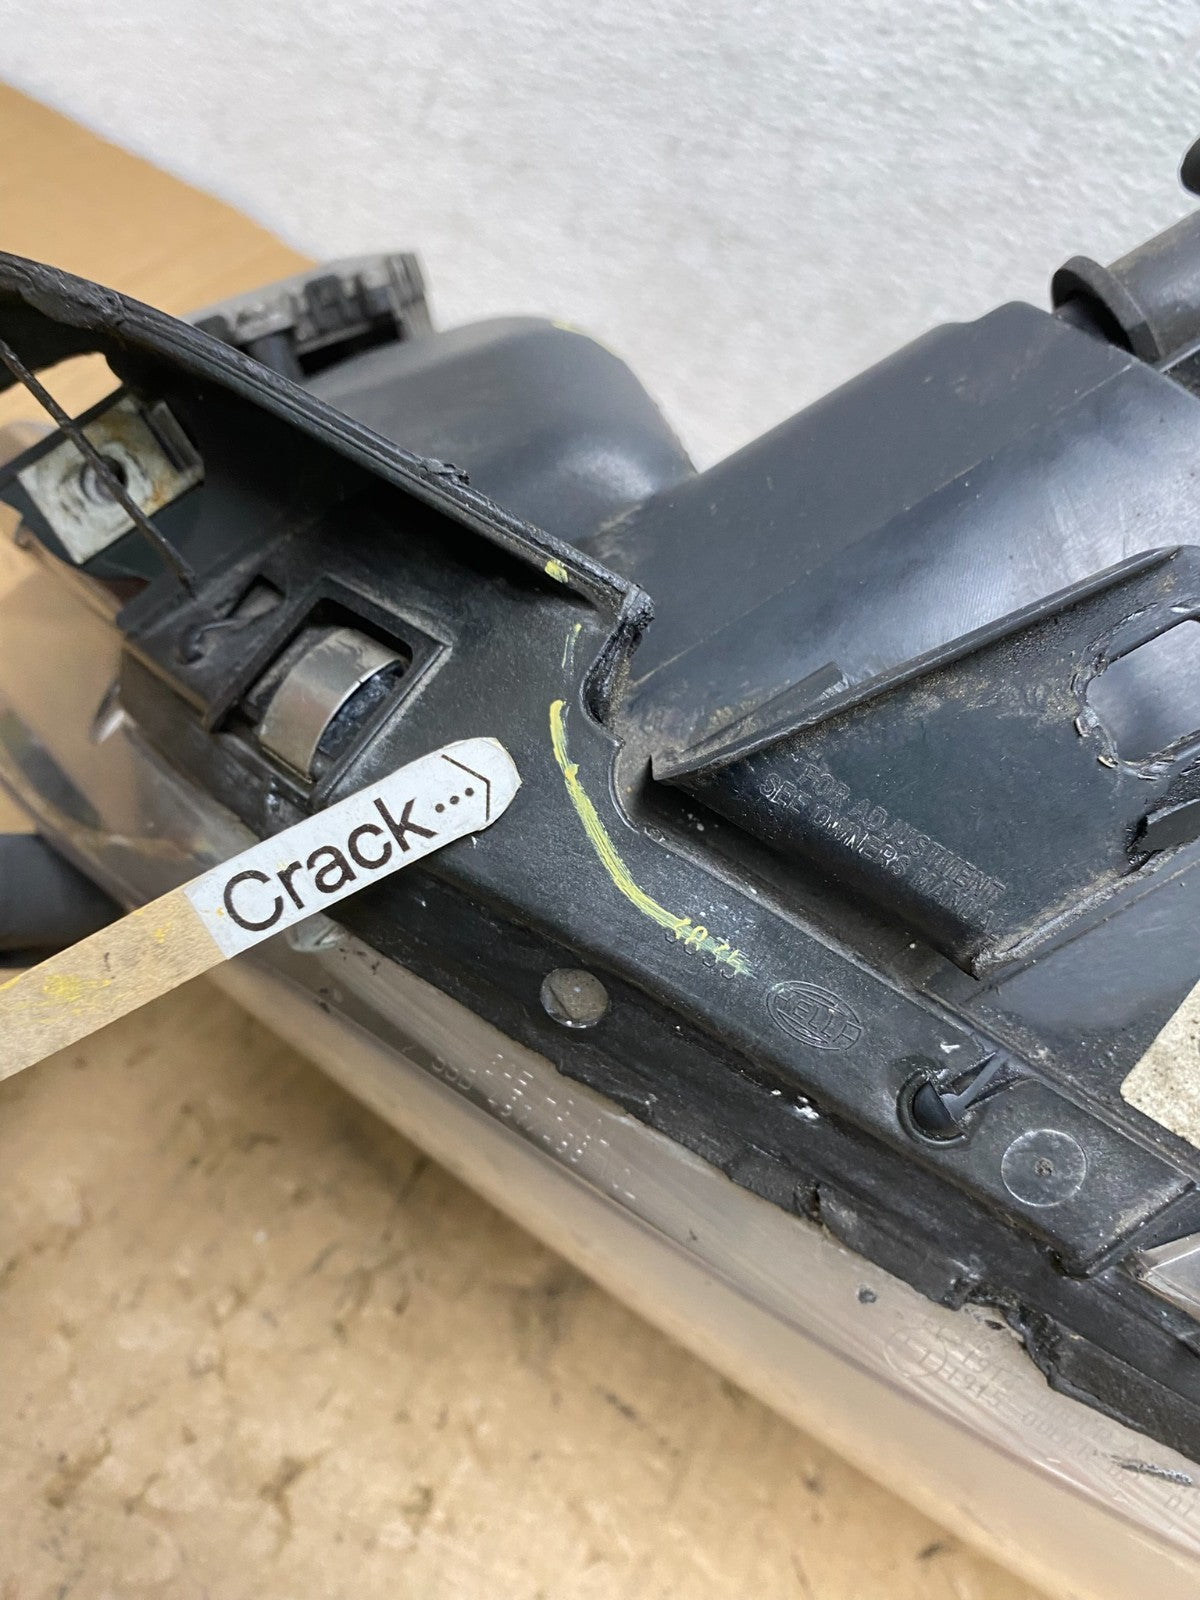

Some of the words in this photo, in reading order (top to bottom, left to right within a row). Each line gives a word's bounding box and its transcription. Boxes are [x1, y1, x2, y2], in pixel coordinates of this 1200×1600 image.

[759, 772, 812, 815] SEE
[811, 804, 911, 876] OWNERS
[798, 763, 850, 808] FOR
[849, 798, 1006, 901] ADJUSTMENT
